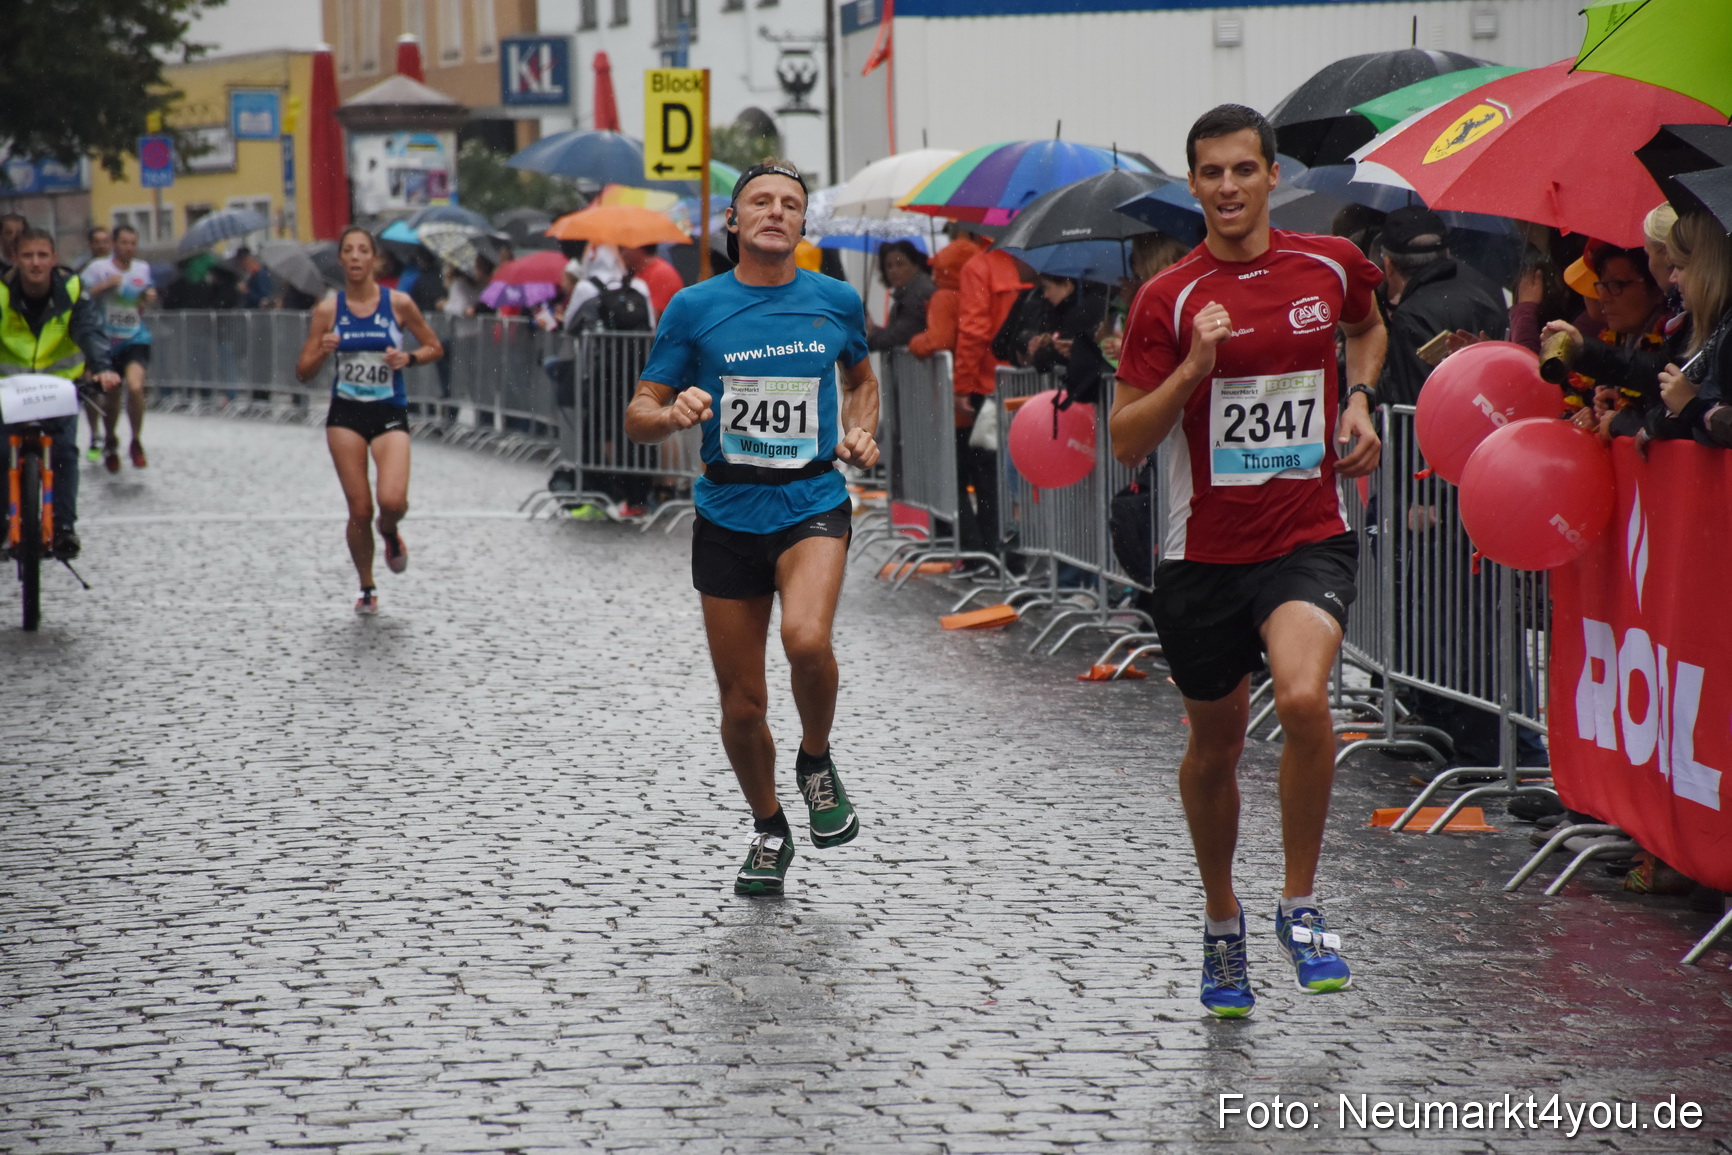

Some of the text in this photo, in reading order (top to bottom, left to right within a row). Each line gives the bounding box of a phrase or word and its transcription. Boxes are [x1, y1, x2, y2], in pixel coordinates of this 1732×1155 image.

[652, 73, 703, 93] Block
[662, 103, 694, 155] D
[1238, 269, 1263, 280] CRAFT
[724, 340, 826, 363] www.hasit.de
[344, 363, 389, 384] 2246
[764, 380, 812, 393] BOCK
[1264, 375, 1317, 393] BOCK
[730, 399, 808, 434] 2491
[1223, 398, 1316, 443] 2347
[740, 439, 799, 459] Wolfgang
[1241, 454, 1301, 470] Thomas
